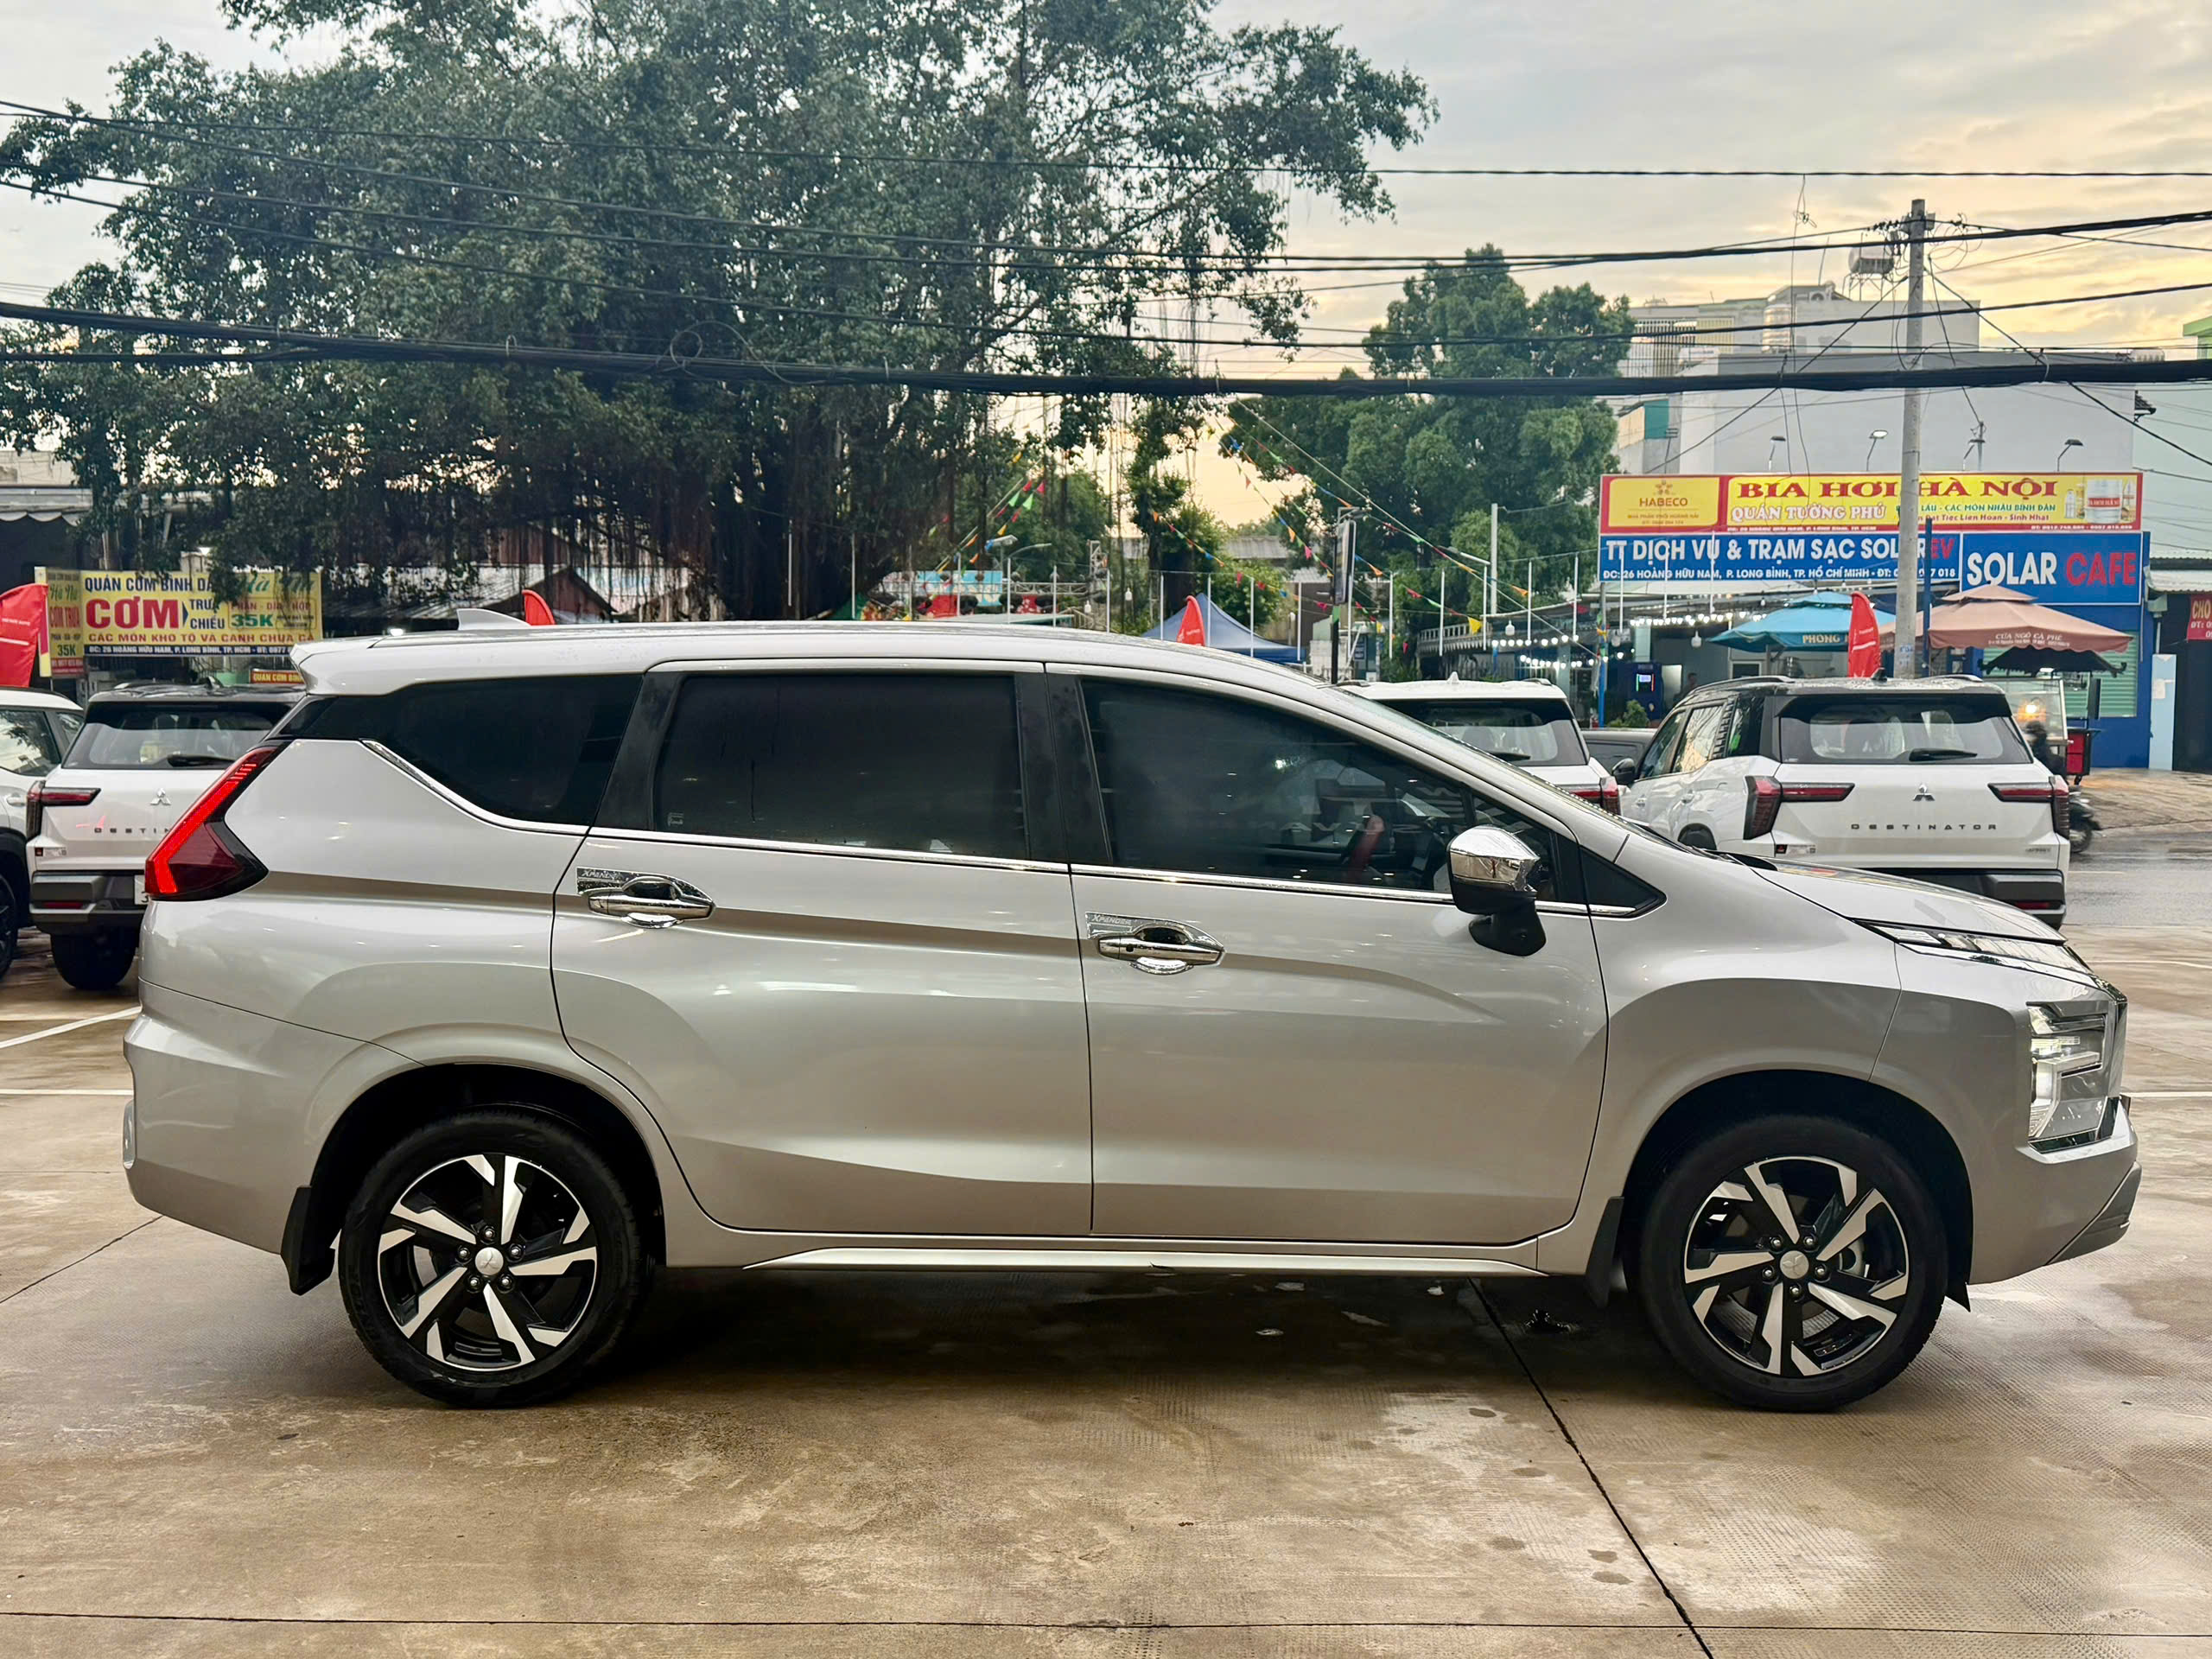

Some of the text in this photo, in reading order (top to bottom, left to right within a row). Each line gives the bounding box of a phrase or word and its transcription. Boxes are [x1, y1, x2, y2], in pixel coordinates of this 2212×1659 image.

[1738, 476, 2058, 500] BIA HƠI HÀ NỘI
[1639, 497, 1688, 507] HABECO
[1731, 502, 1782, 522] QUÁN
[1851, 501, 1886, 520] PHÚ
[1605, 540, 1627, 560] TT
[1632, 539, 1685, 565] DỊCH
[1691, 539, 1721, 565] VỤ
[1726, 539, 1742, 560] &
[1748, 538, 1805, 564] TRẠM
[1810, 537, 1856, 564] SẠC
[1637, 567, 1673, 579] HOÀNG
[1675, 567, 1695, 579] HỮU
[1737, 569, 1763, 578] LONG
[1808, 564, 1823, 578] HỒ
[1826, 565, 1844, 578] CHÍ
[1845, 568, 1869, 577] MINH
[1937, 568, 1955, 577] 018
[1967, 551, 2137, 586] SOLAR CAFE
[85, 574, 121, 593] QUÁN
[126, 575, 156, 593] CƠM
[162, 575, 193, 593] BÌNH
[86, 595, 180, 629] CƠM
[231, 613, 273, 627] 35K
[190, 614, 225, 629] CHIỀU
[88, 632, 113, 642] CÁC
[118, 632, 146, 642] MÓN
[151, 633, 176, 642] KHO
[200, 632, 217, 642] VÀ
[221, 633, 255, 642] CANH
[260, 633, 294, 642] CHUA
[57, 644, 76, 657] 35K
